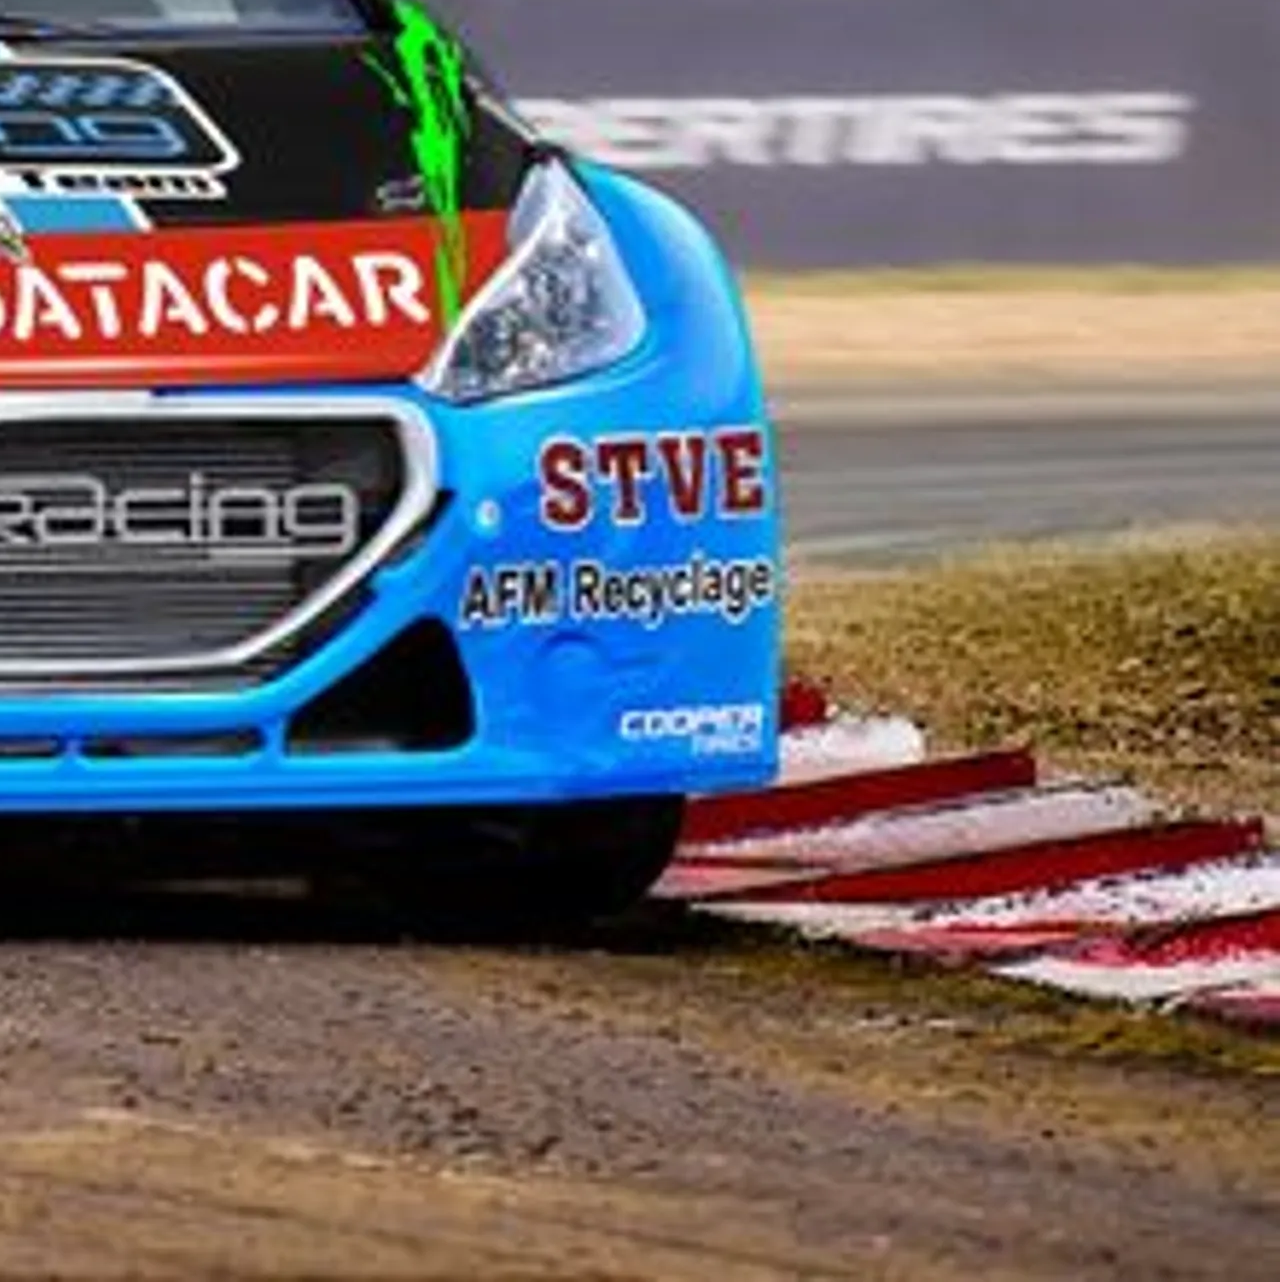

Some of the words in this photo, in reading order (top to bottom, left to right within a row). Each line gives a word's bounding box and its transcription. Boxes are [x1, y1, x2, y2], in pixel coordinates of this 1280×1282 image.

[6, 168, 214, 194] Team
[538, 433, 767, 530] STVE
[460, 566, 558, 626] AFM
[572, 557, 774, 626] Recyclage
[621, 705, 765, 738] COOPER
